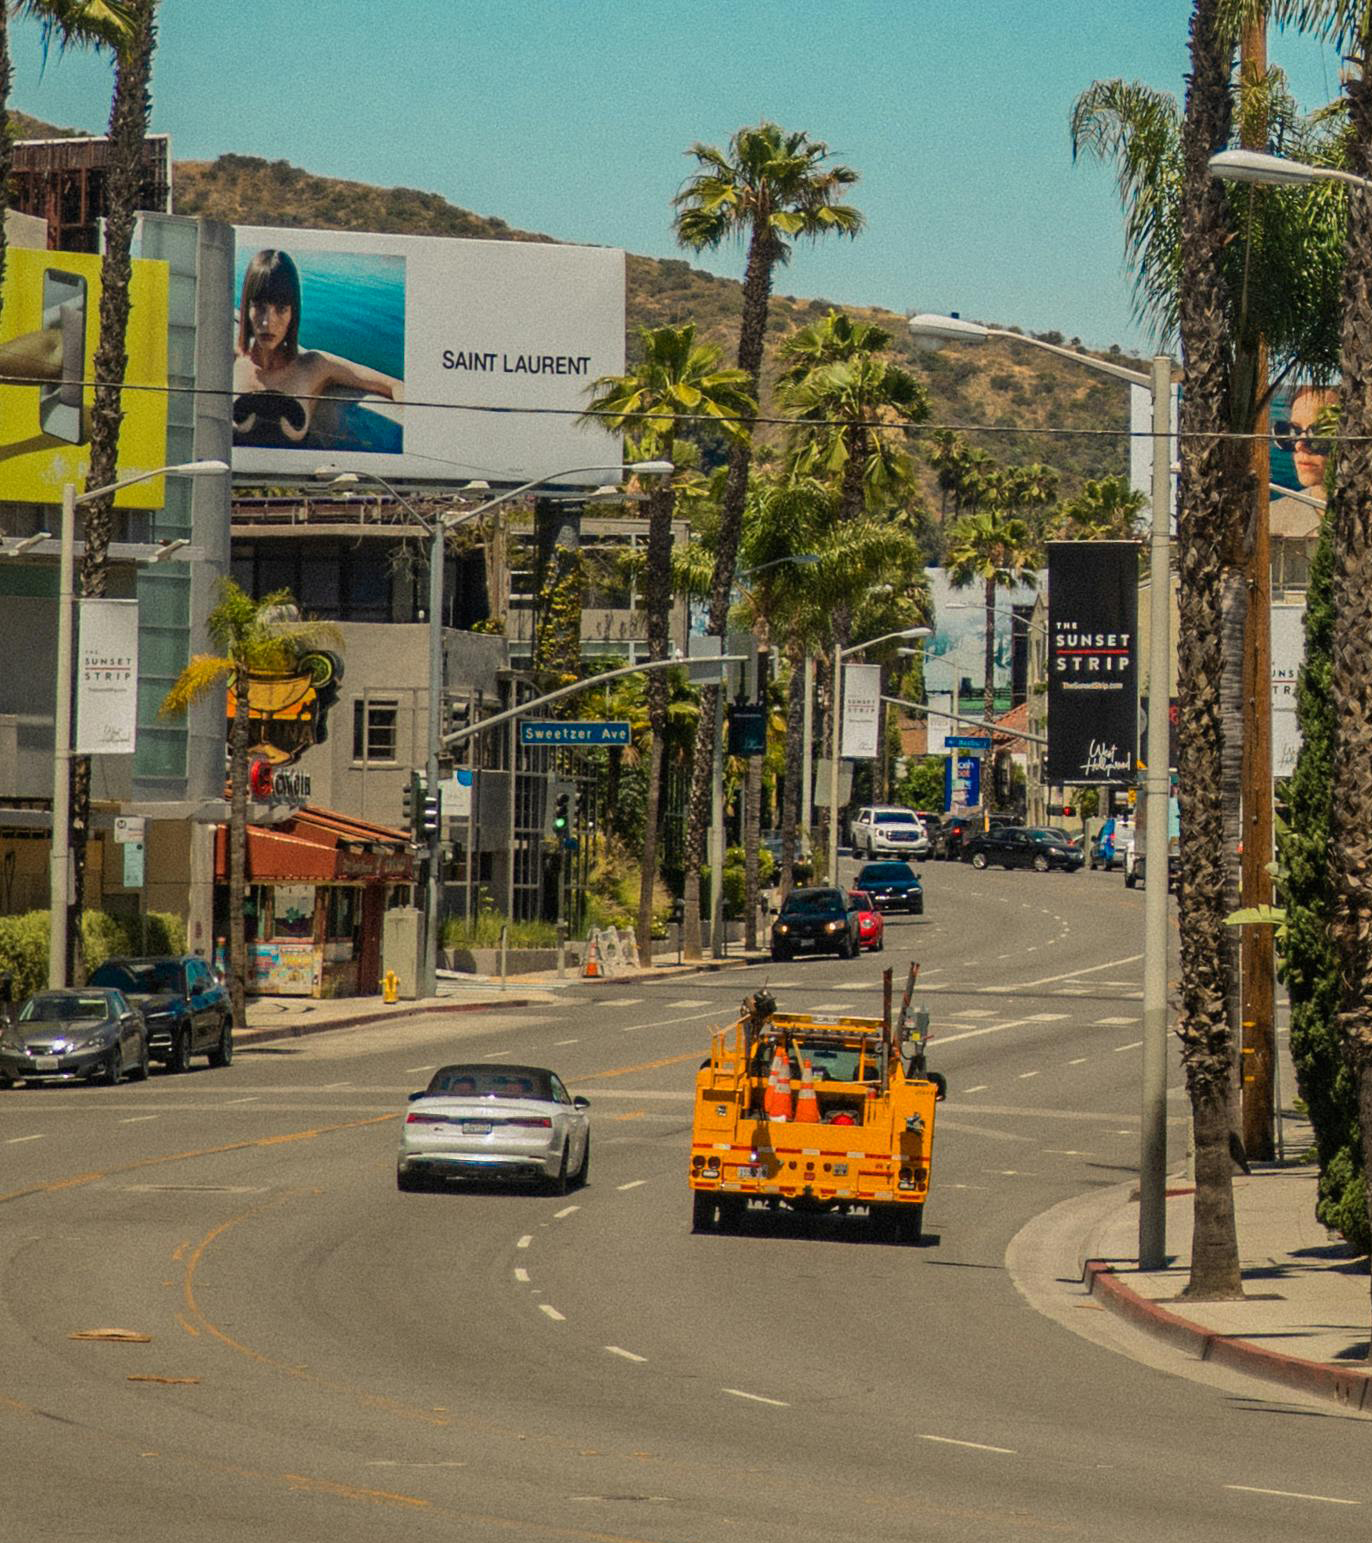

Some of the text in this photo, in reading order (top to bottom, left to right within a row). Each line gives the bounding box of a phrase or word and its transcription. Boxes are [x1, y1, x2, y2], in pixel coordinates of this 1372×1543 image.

[442, 350, 591, 375] SAINT LAURENT
[1056, 634, 1130, 647] SUNSET
[1057, 657, 1130, 671] STRIP
[526, 727, 626, 740] Sweetzer Ave
